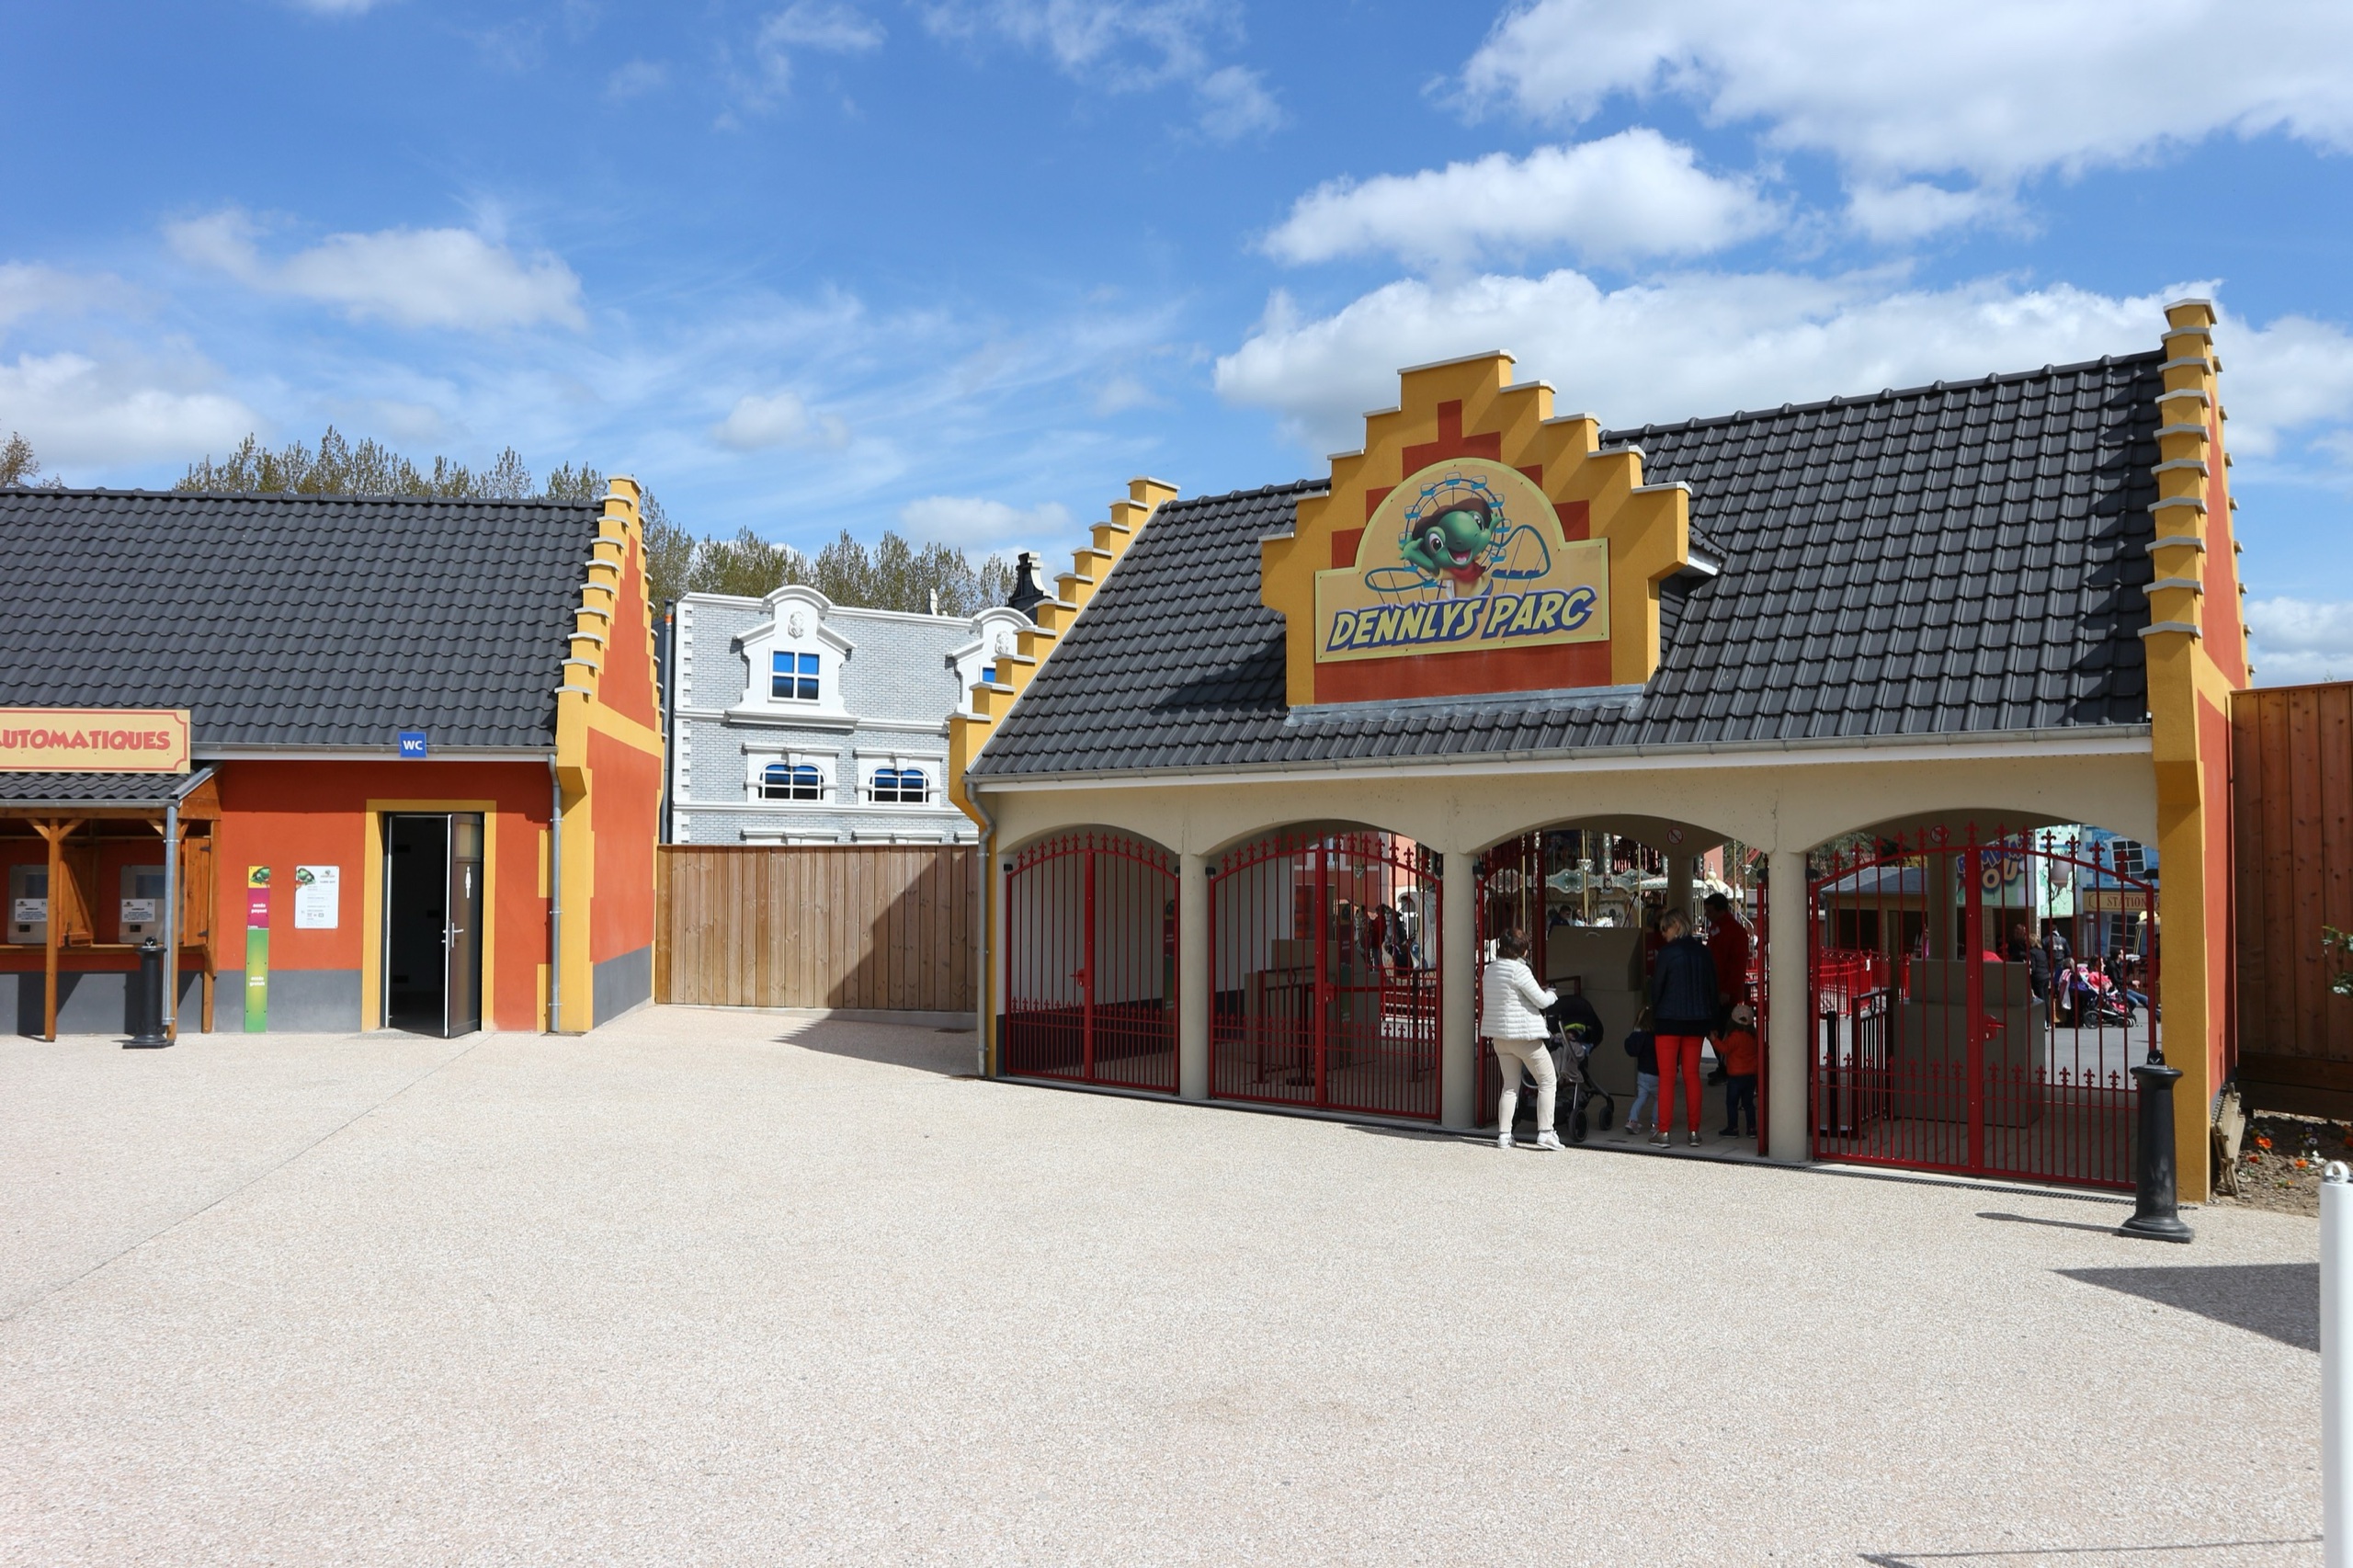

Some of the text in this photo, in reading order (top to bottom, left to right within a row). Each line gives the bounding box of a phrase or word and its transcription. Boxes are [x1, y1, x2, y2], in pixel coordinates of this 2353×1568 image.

[1326, 585, 1597, 650] DENNLYS PARC
[0, 729, 171, 751] UTOMATIQUES
[403, 740, 424, 751] WC
